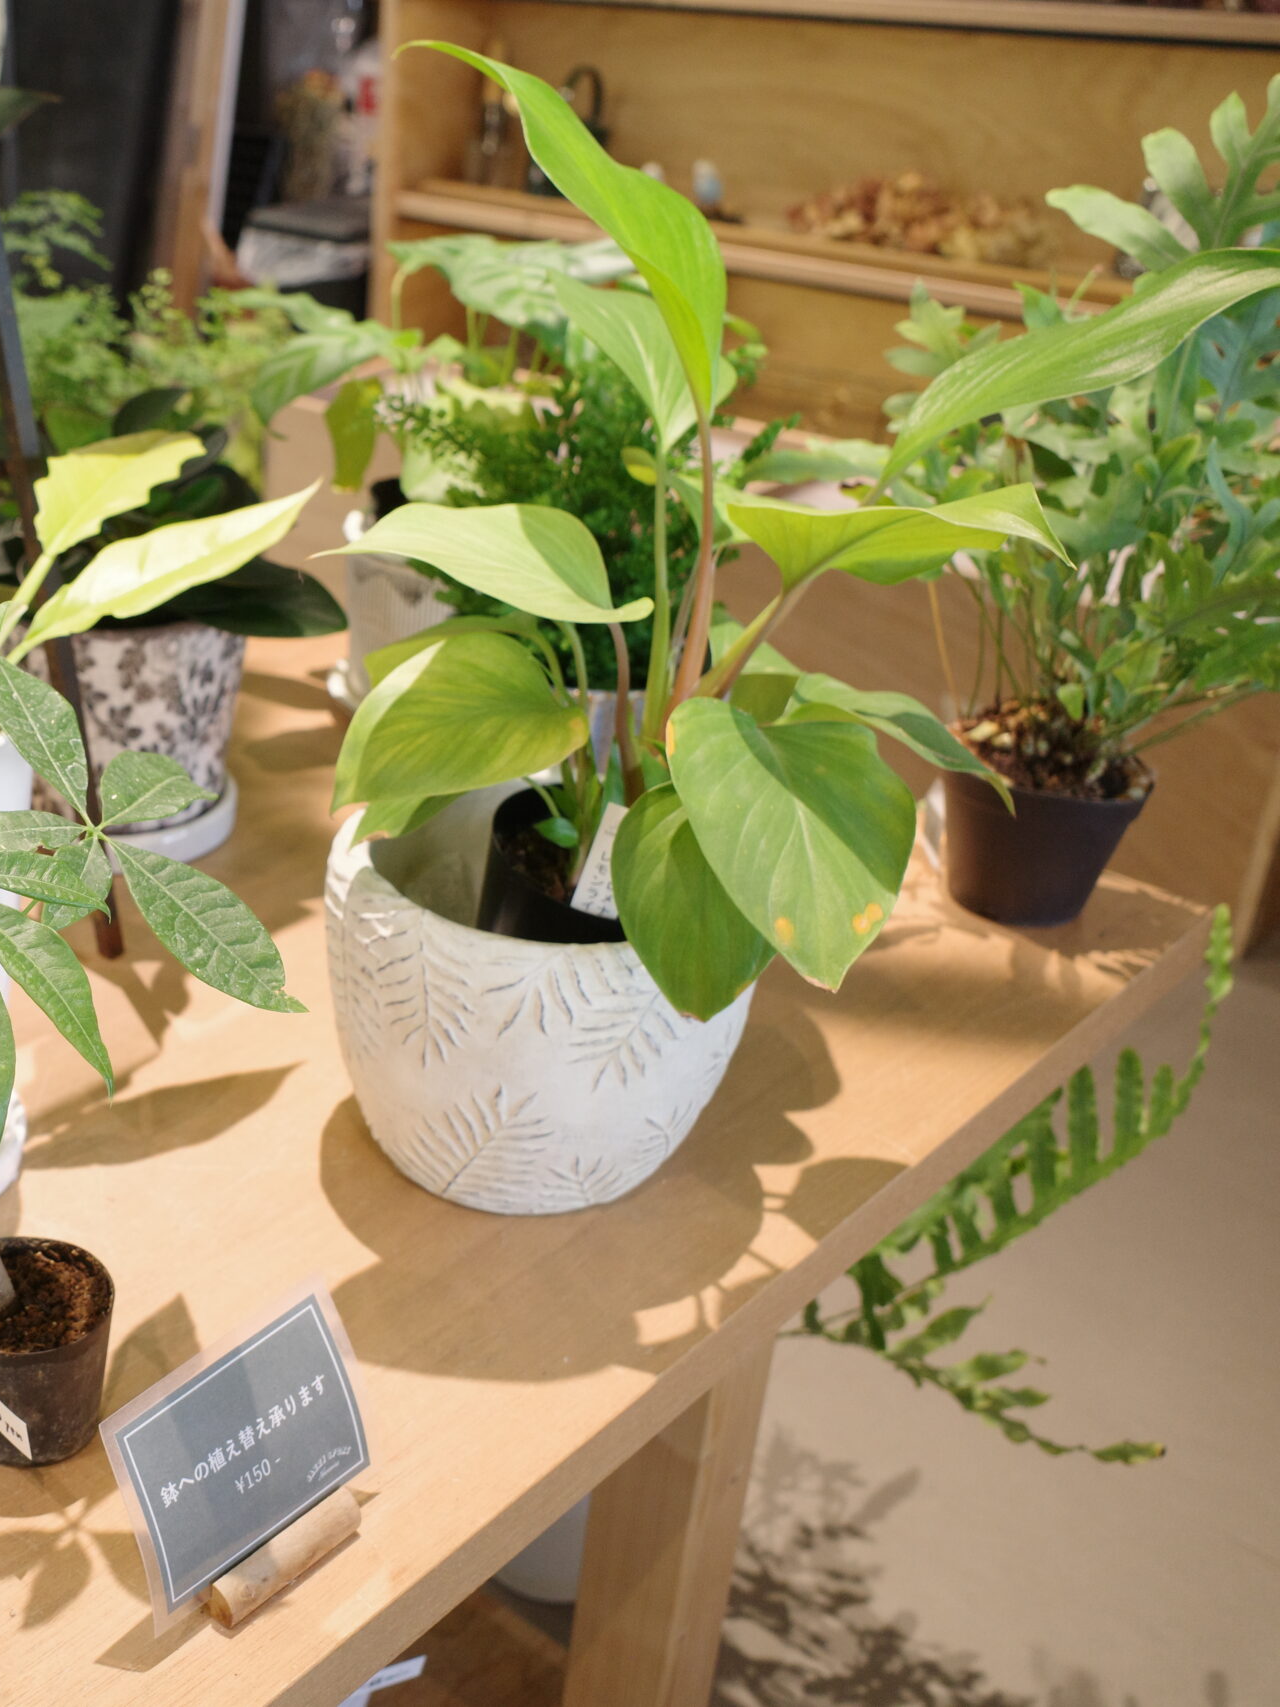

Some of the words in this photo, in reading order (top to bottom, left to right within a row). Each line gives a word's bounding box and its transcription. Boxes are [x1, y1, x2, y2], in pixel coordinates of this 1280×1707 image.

[160, 1374, 325, 1508] 鉢への植え替え承ります
